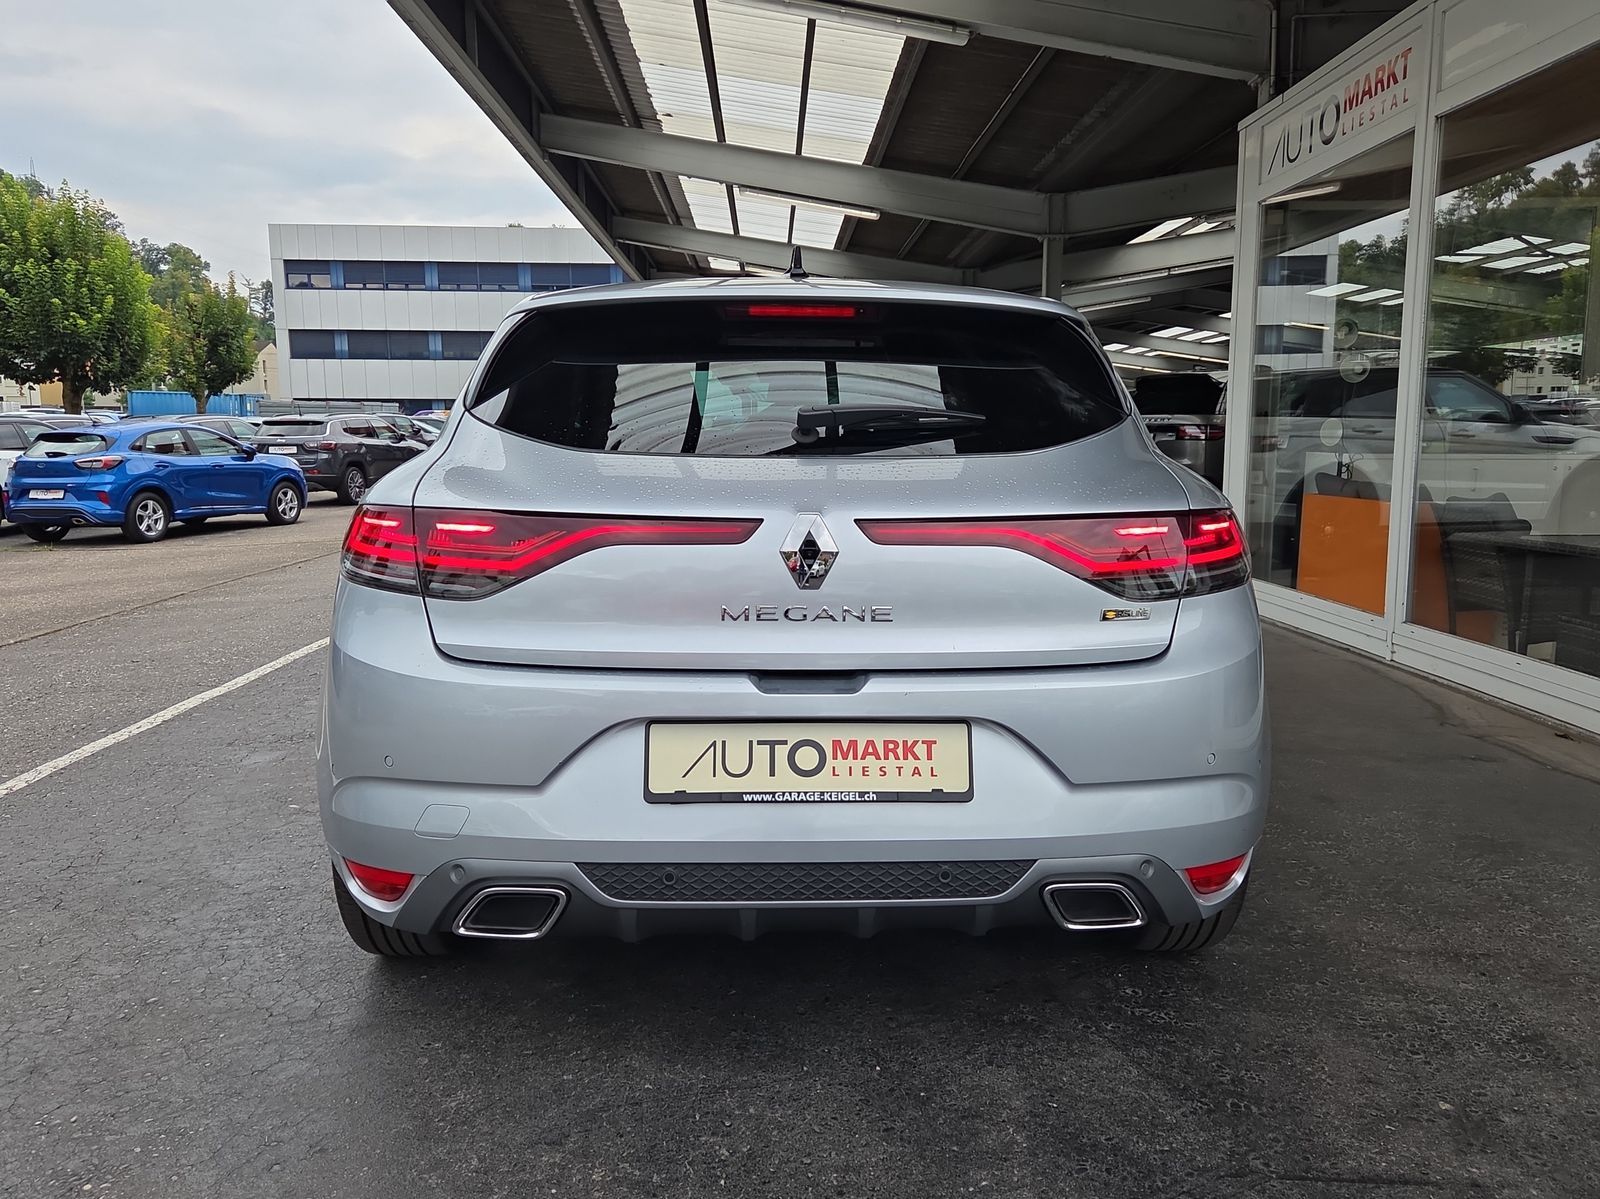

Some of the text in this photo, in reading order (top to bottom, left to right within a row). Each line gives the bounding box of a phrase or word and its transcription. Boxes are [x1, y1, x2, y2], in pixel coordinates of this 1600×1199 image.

[1268, 47, 1412, 175] AUTO MARKT
[1342, 88, 1409, 136] LIESTAL
[721, 605, 893, 622] MEGANE
[682, 739, 937, 778] AUTO MARKT
[832, 766, 937, 777] LIESTAL
[743, 792, 877, 801] www.GARAGE-KEIGEL.ch
